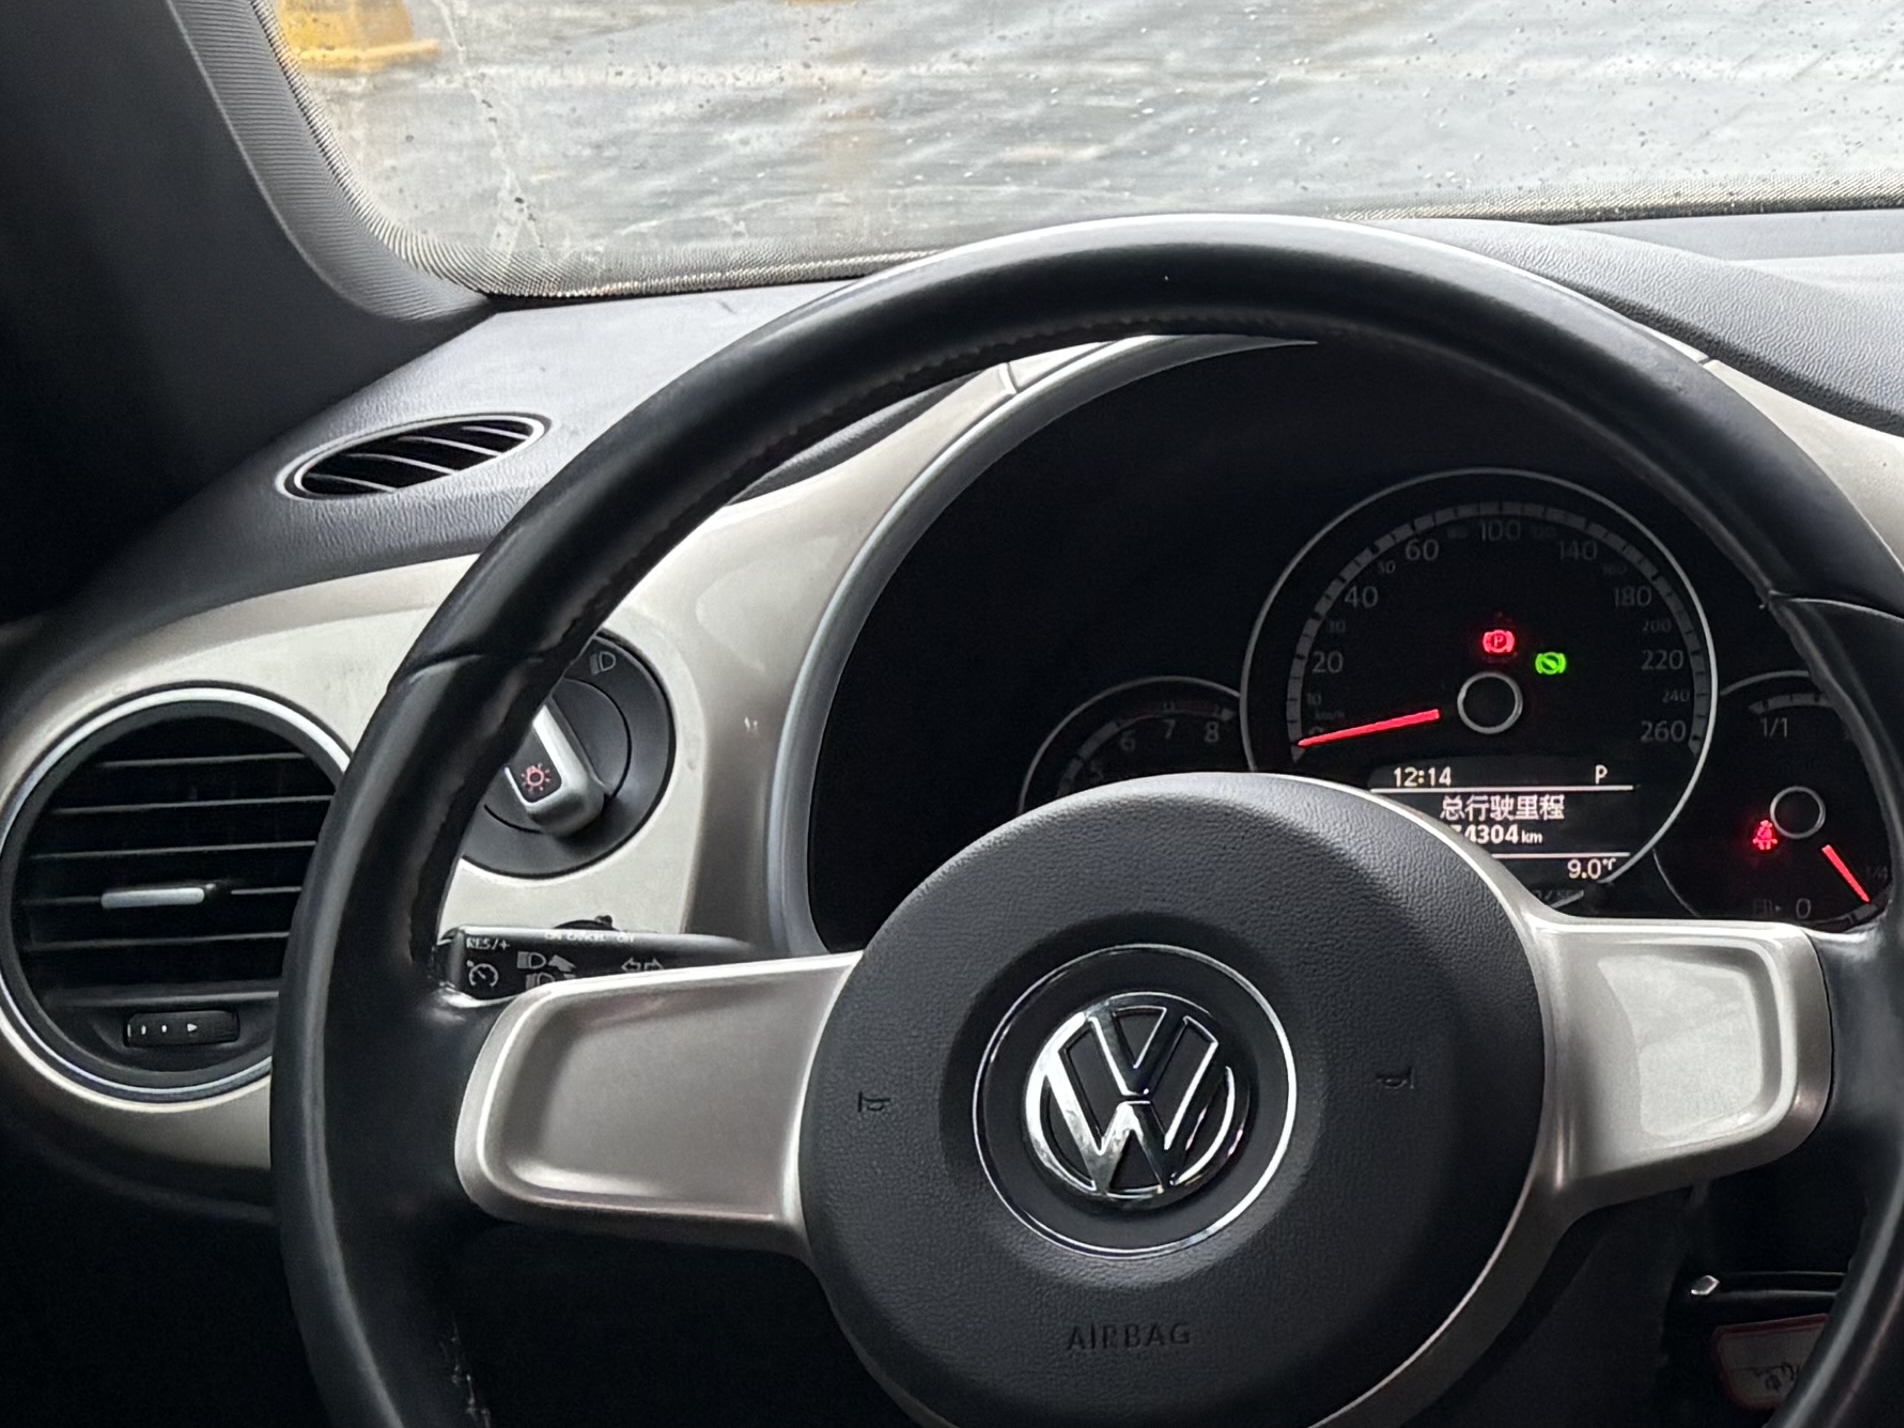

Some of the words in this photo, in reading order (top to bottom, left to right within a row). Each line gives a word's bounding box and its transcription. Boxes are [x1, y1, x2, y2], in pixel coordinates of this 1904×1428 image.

[1480, 518, 1522, 542] 100
[1404, 538, 1440, 563] 60
[1558, 538, 1598, 563] 140
[1343, 585, 1380, 609] 40
[1612, 585, 1653, 609] 180
[1312, 651, 1344, 675] 20
[1641, 650, 1685, 672] 220
[1162, 718, 1178, 740] 7
[1203, 720, 1220, 744] 8
[1640, 720, 1688, 745] 260
[1759, 716, 1789, 738] 1/1
[1119, 730, 1136, 753] 6
[1393, 767, 1453, 788] 12:14
[1594, 765, 1608, 785] P
[1440, 794, 1565, 822] 总行驶里程
[1520, 827, 1544, 844] km
[1066, 1322, 1191, 1351] AIRBAG
